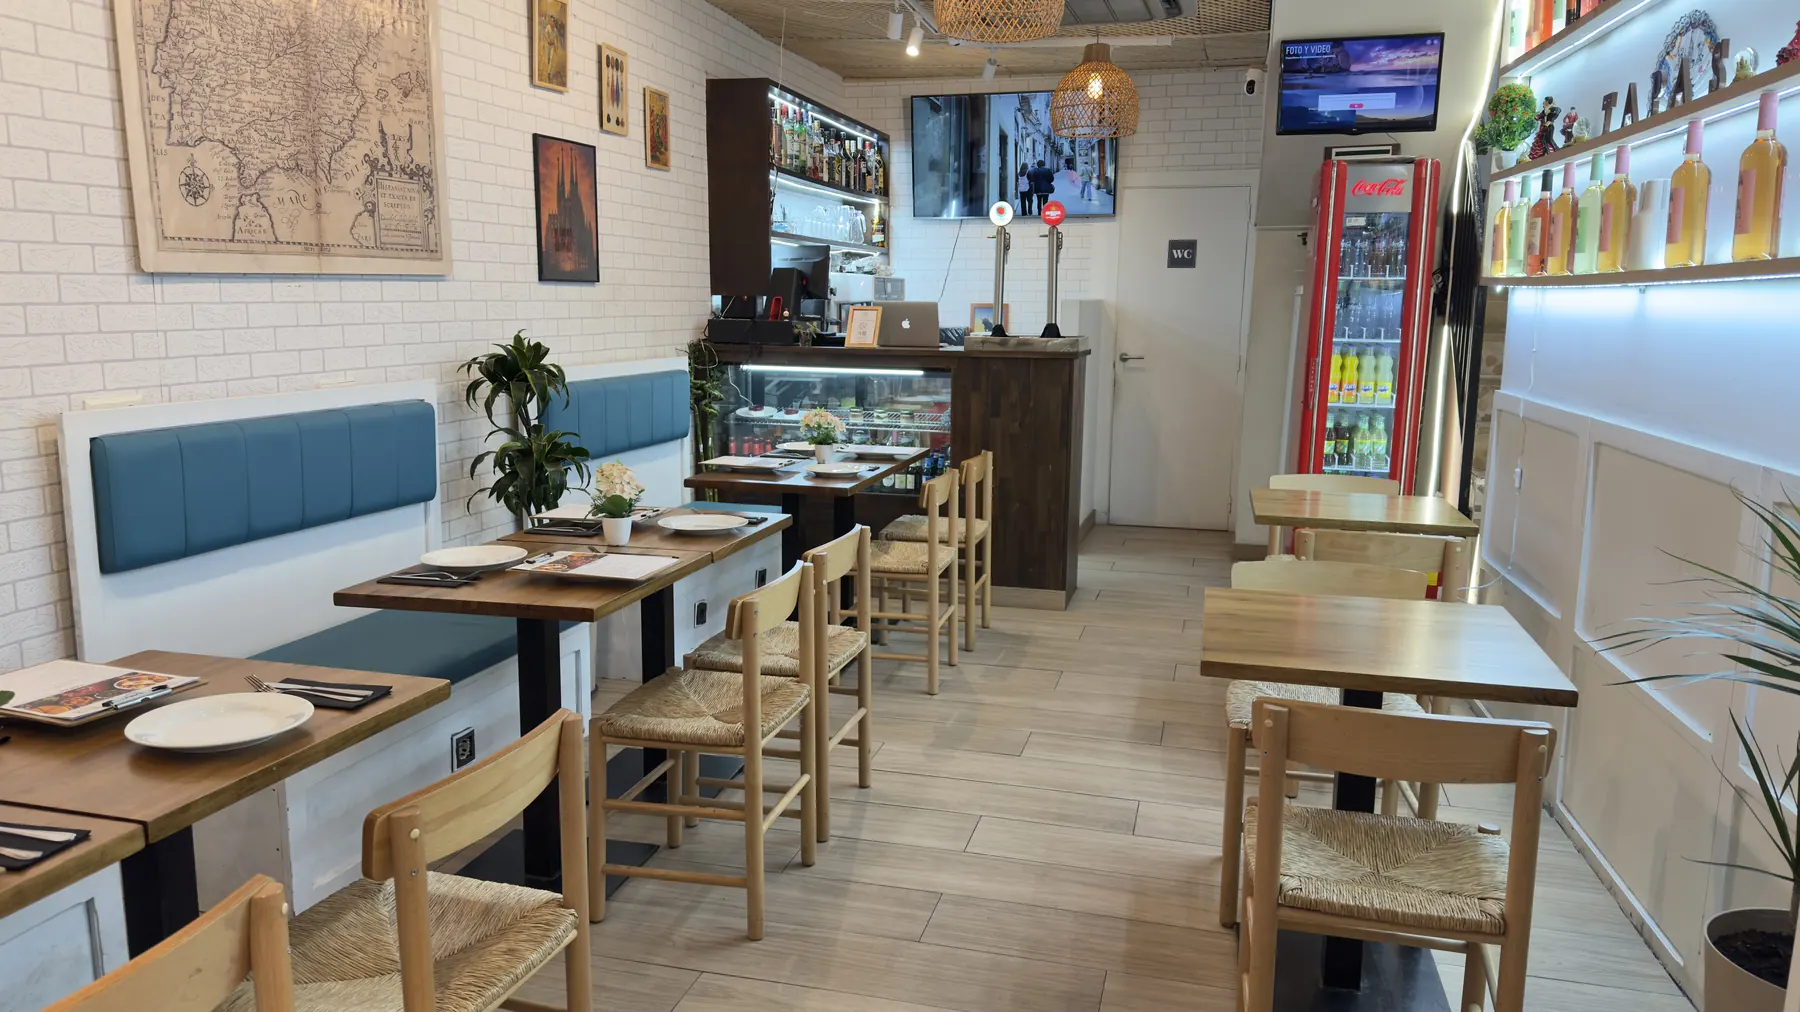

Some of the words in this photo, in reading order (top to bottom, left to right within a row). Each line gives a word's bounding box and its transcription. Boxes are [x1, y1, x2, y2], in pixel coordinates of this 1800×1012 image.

[1286, 46, 1302, 55] FOTO
[1304, 46, 1310, 54] Y
[1311, 44, 1331, 54] VIDEO
[1602, 38, 1730, 135] TAPAS
[1351, 178, 1407, 196] Coca-Cola
[1172, 249, 1193, 259] WC
